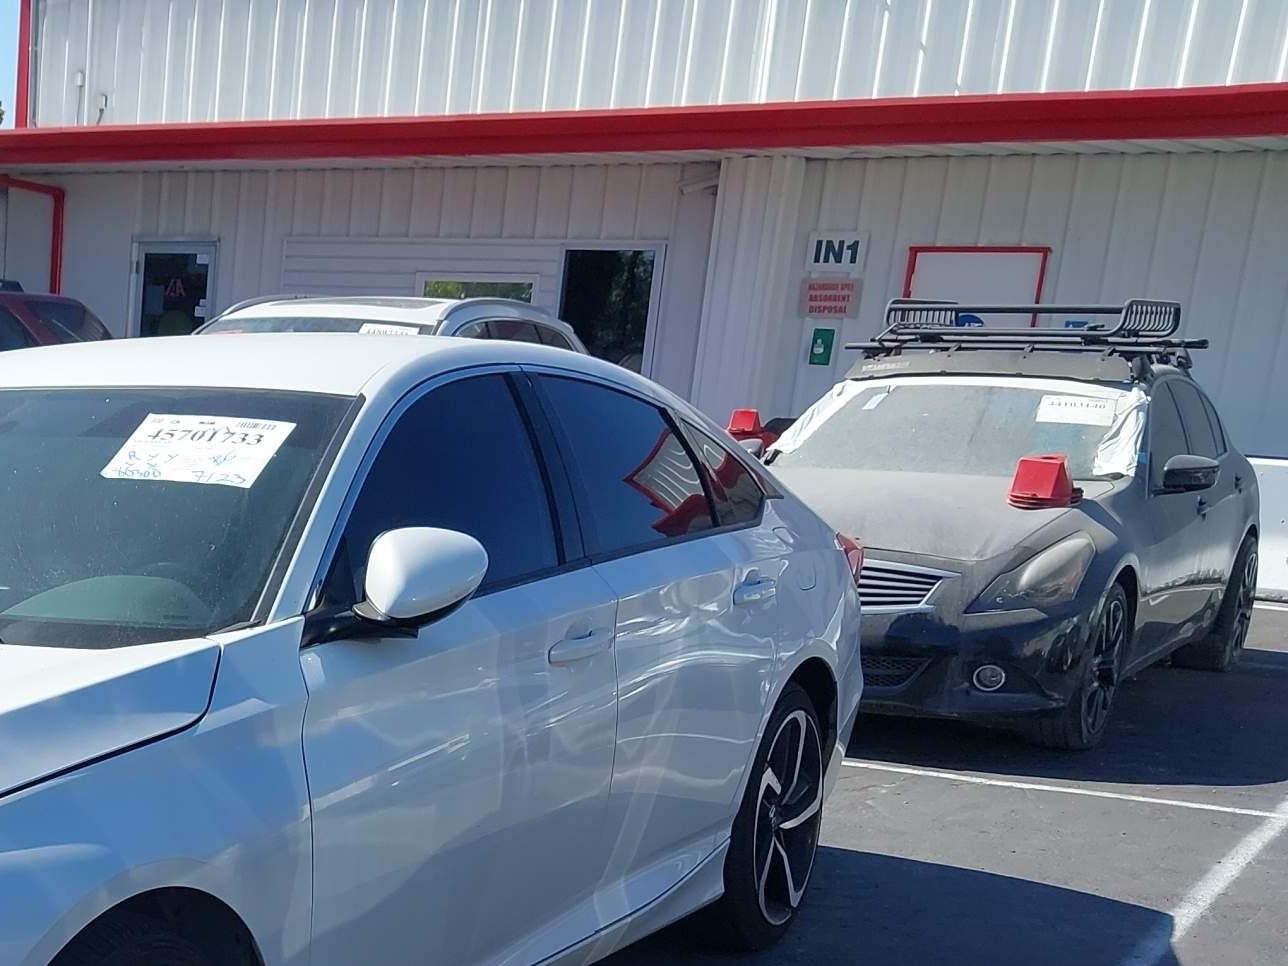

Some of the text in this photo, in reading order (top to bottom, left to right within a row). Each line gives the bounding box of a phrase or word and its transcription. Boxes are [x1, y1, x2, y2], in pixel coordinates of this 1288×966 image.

[813, 239, 860, 264] IN1
[808, 305, 847, 314] DISPOSAL
[147, 428, 265, 446] 45701733
